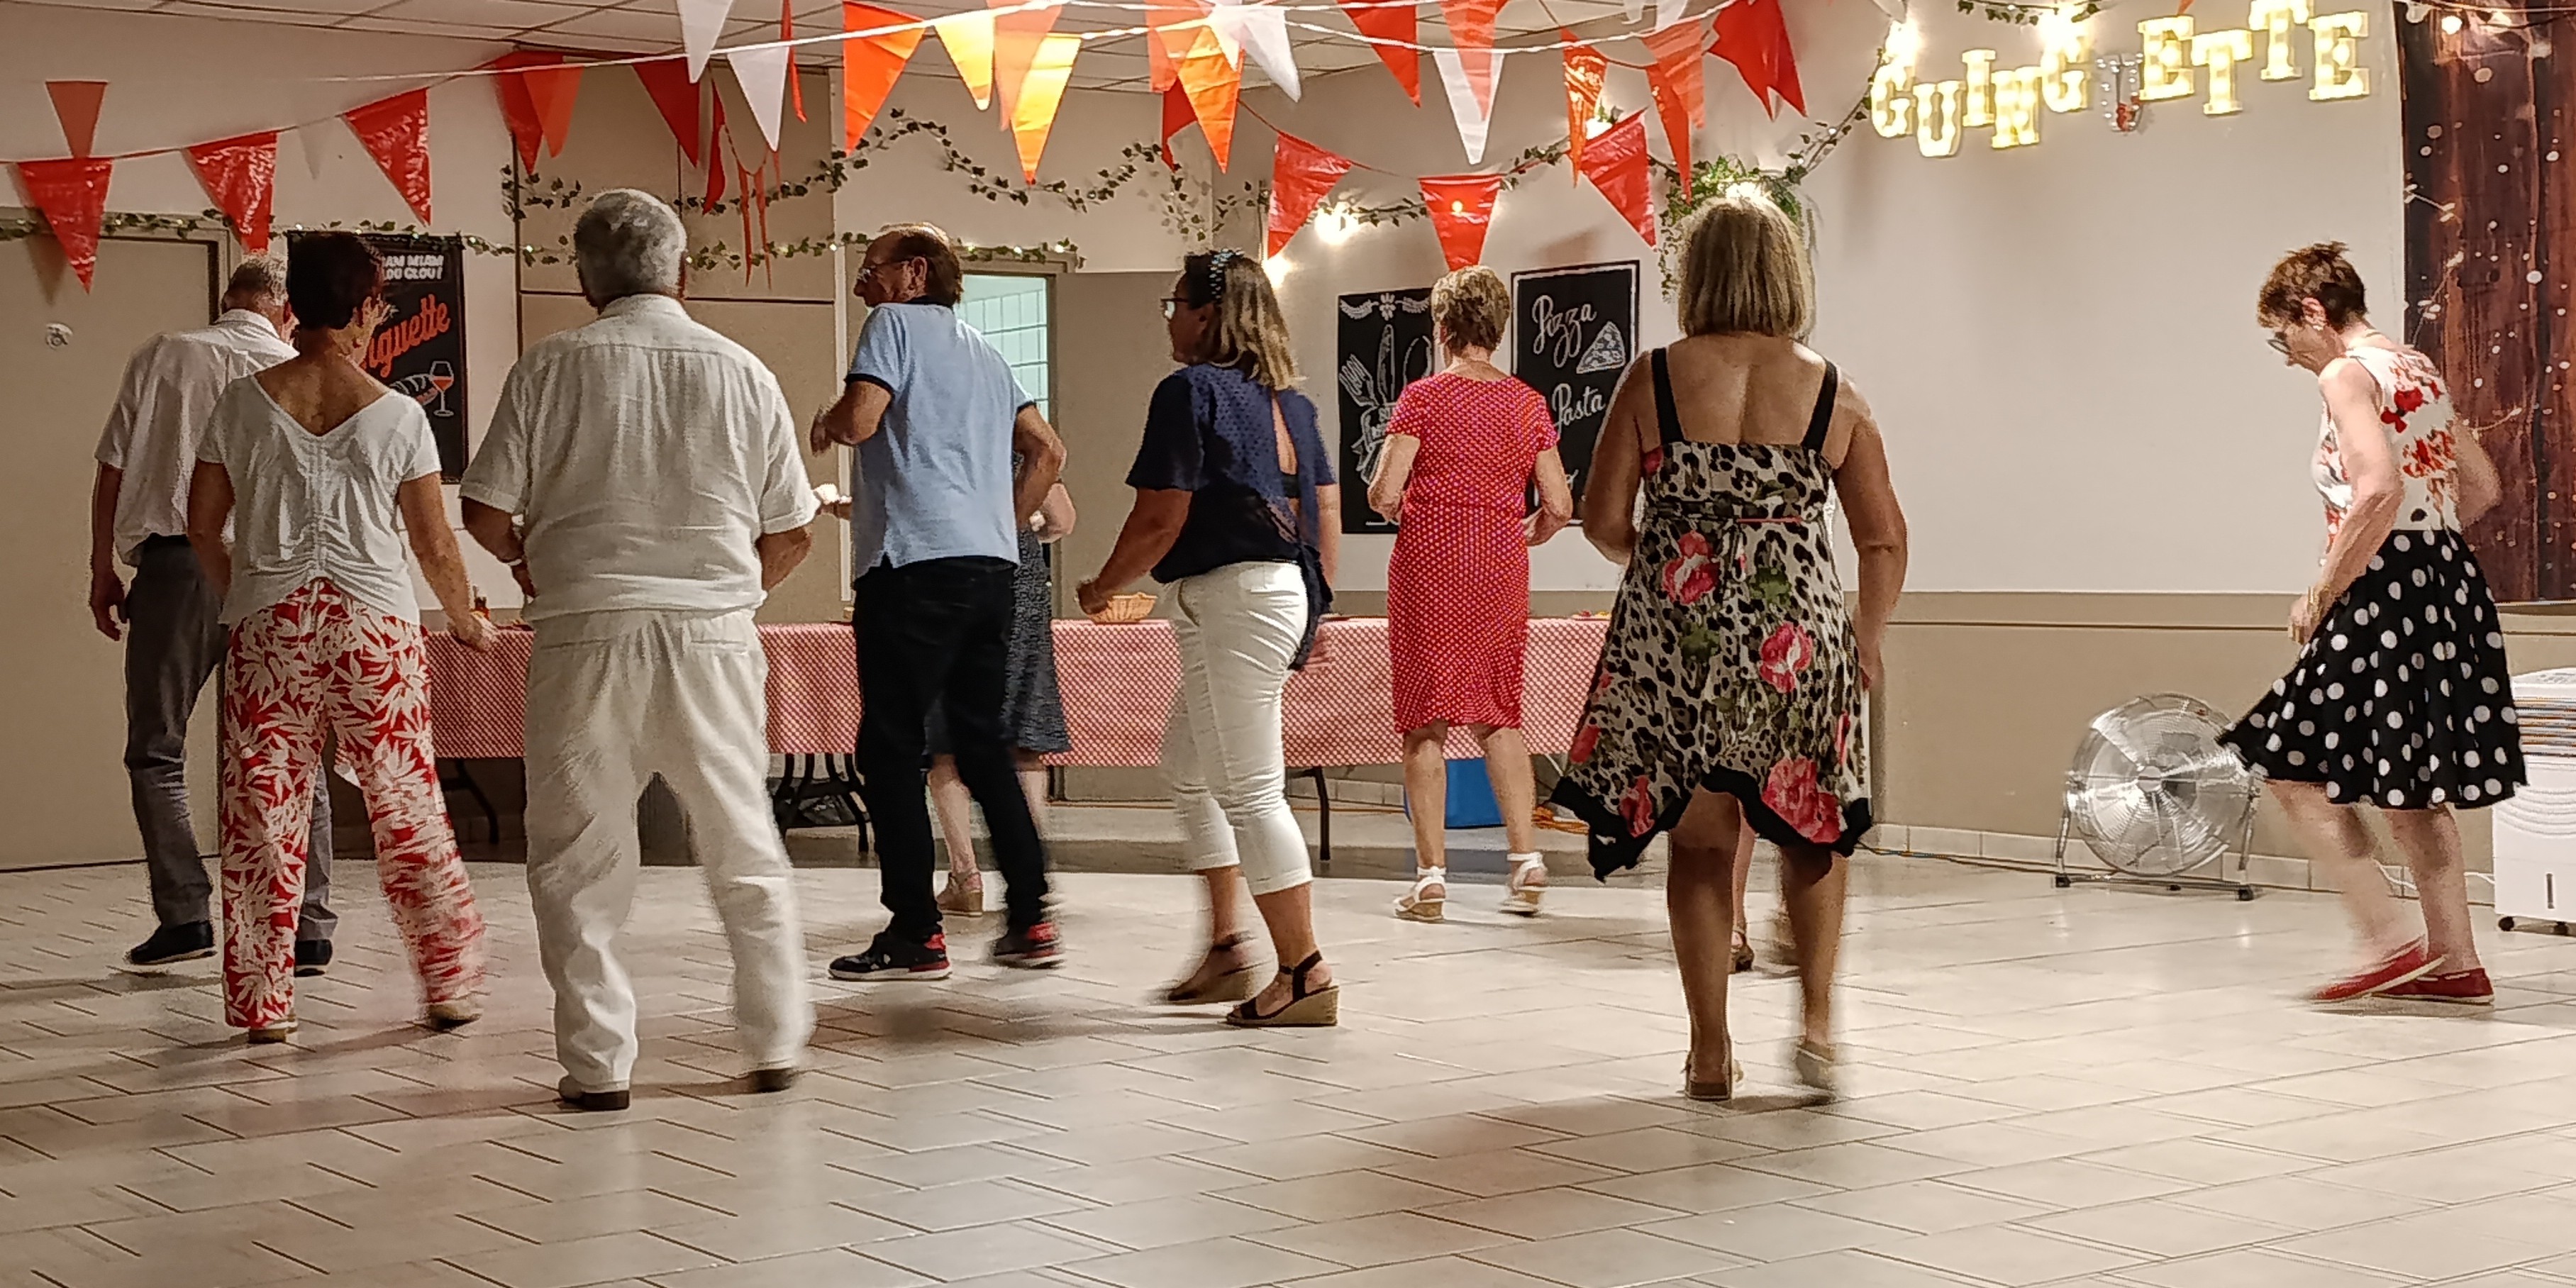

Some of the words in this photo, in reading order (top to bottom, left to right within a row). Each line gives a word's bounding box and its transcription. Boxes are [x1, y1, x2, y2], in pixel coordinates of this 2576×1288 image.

[407, 255, 444, 267] MIAM
[1532, 294, 1597, 368] Pizza
[1552, 383, 1606, 438] Pasta
